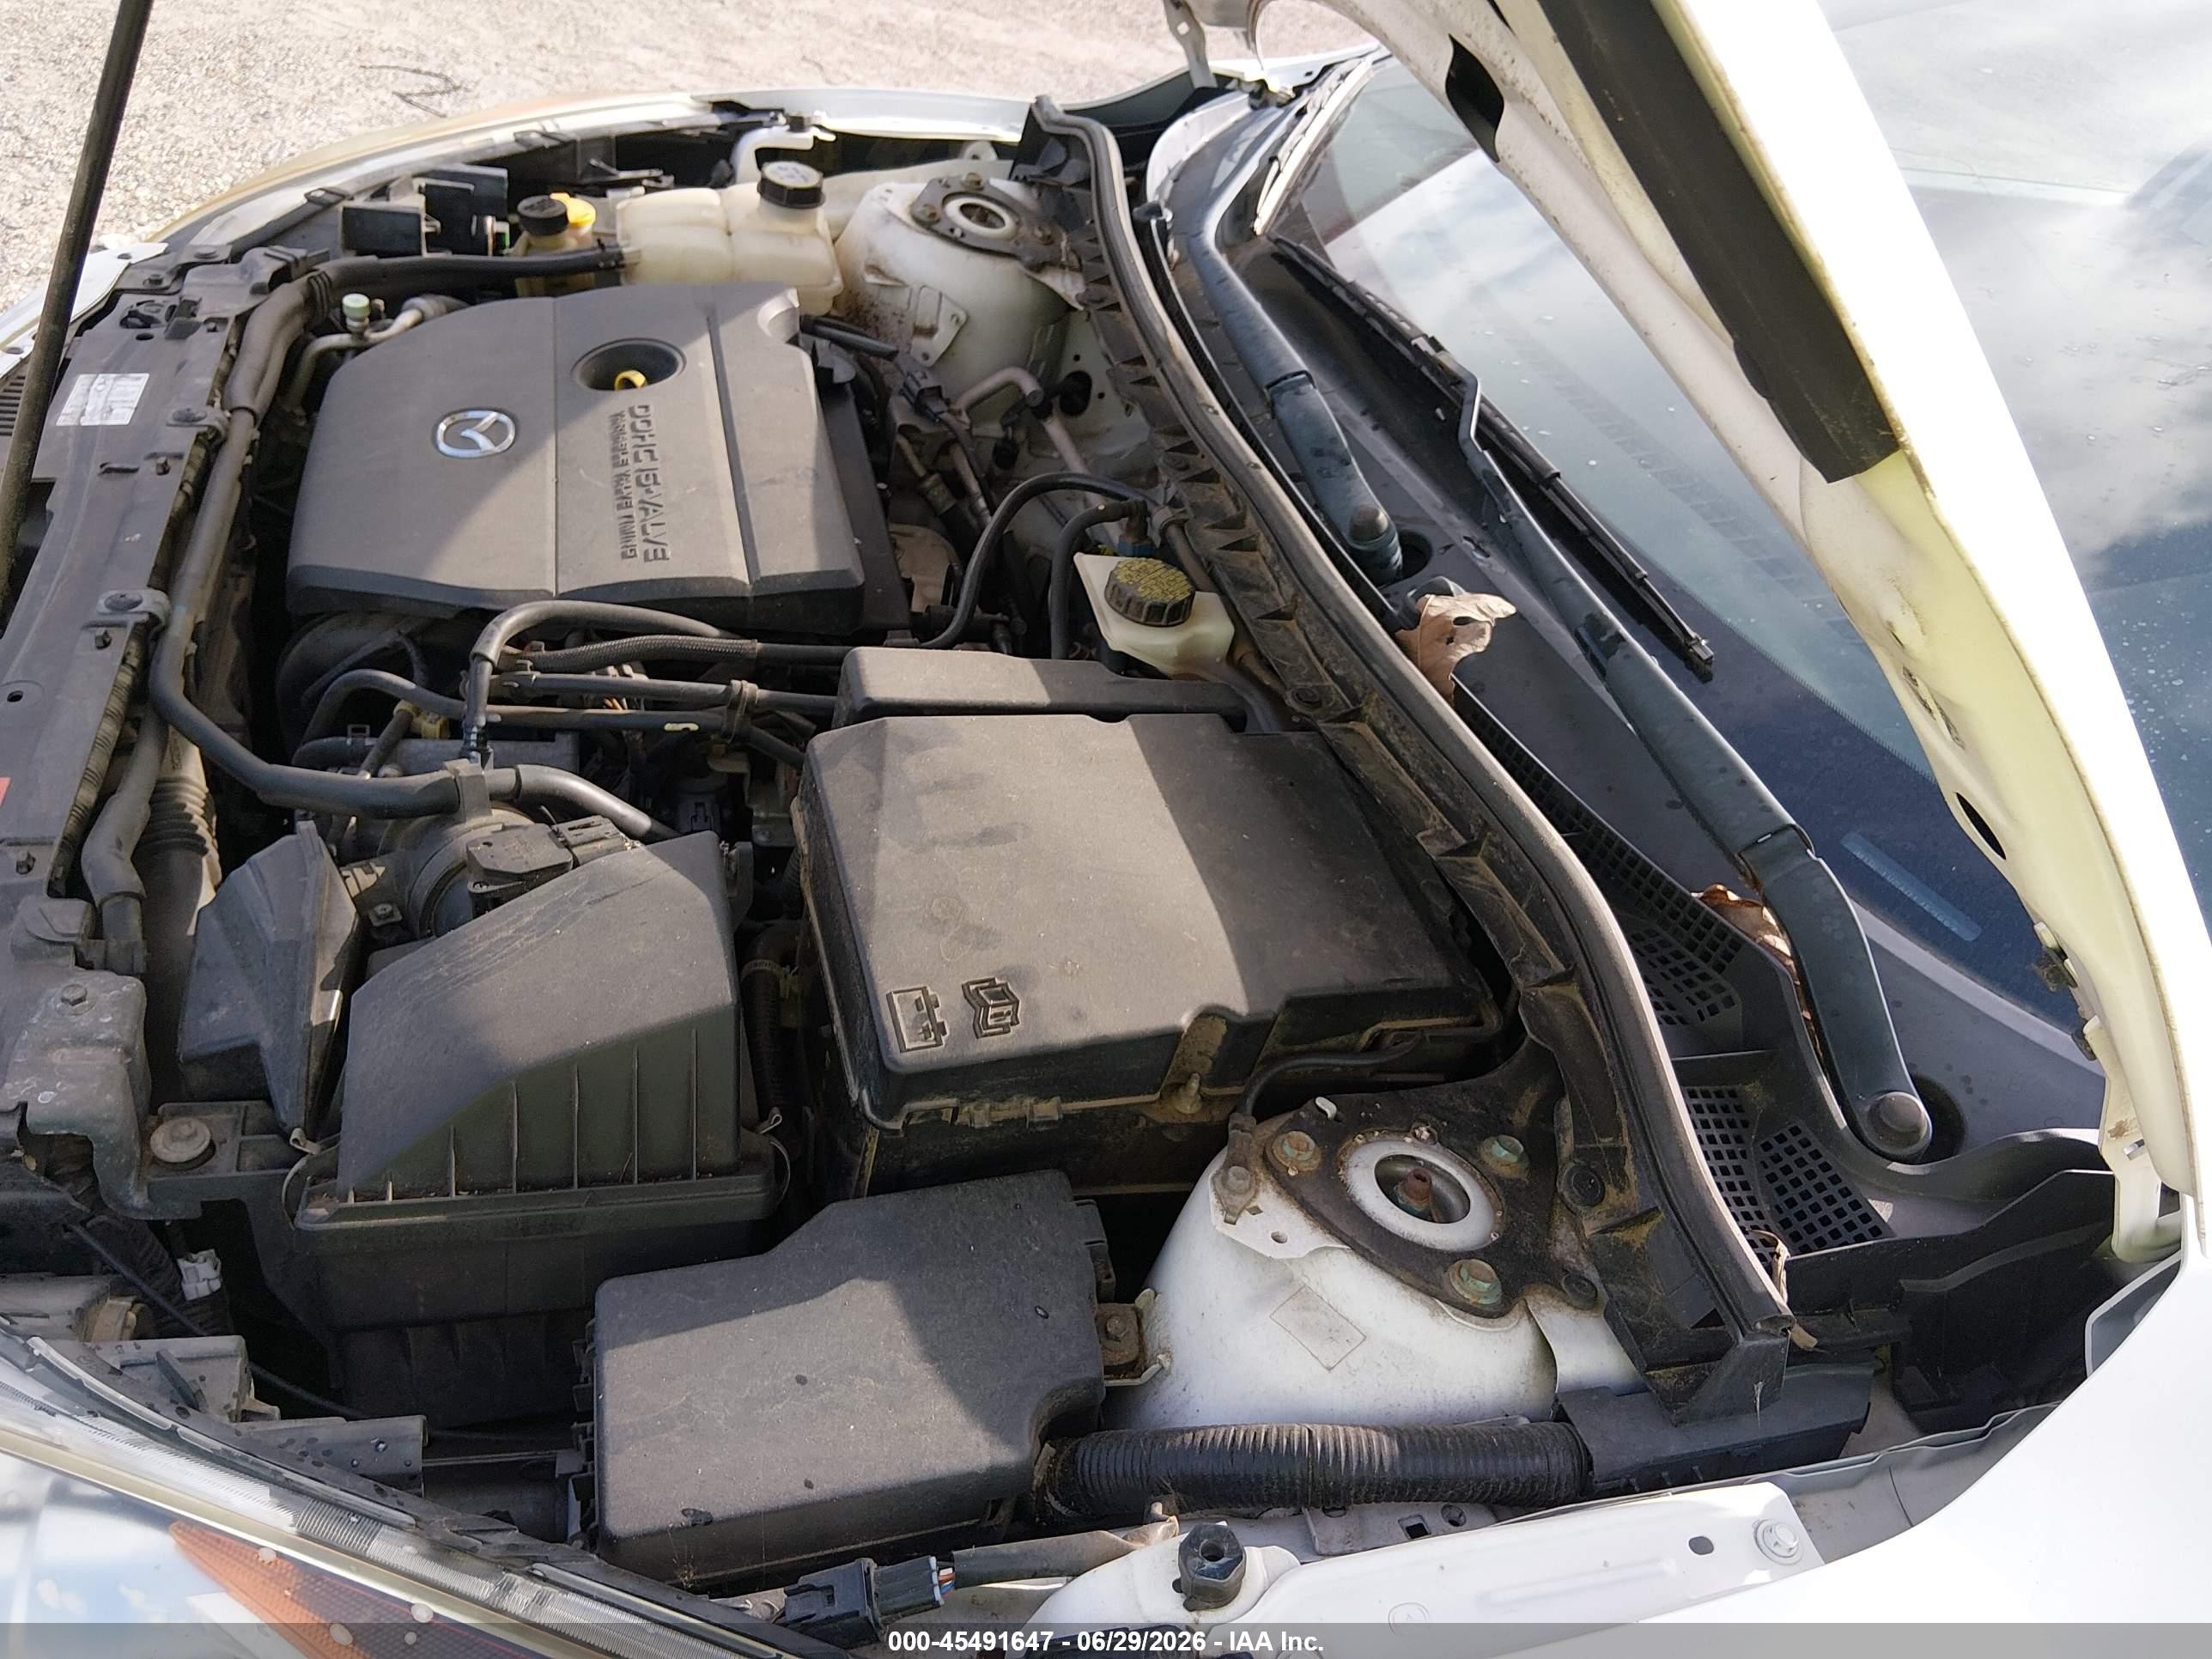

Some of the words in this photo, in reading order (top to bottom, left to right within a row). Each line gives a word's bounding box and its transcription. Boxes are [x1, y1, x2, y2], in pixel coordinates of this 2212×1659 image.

[628, 404, 659, 463] DOHC
[613, 469, 634, 512] VALVE
[635, 466, 671, 562] 16-VALVE
[617, 514, 638, 560] TIMING
